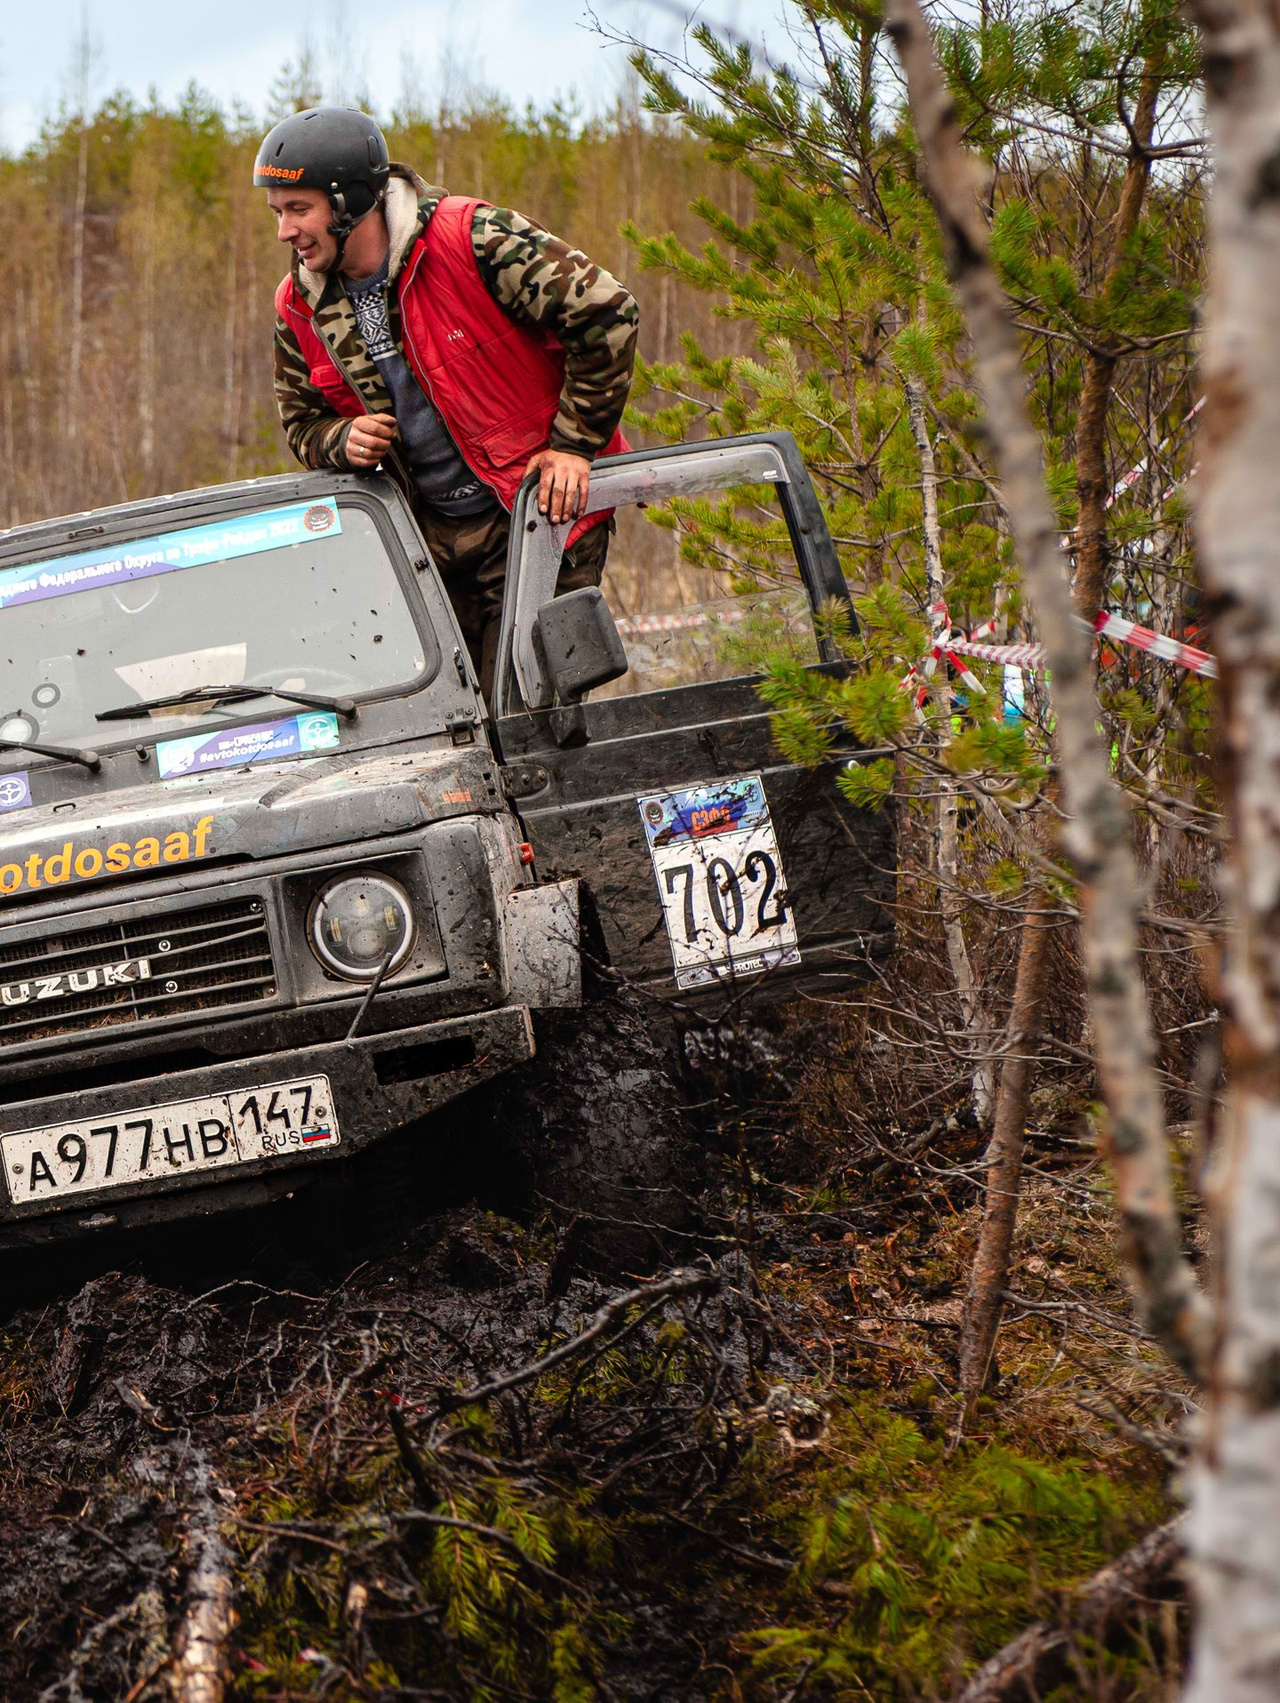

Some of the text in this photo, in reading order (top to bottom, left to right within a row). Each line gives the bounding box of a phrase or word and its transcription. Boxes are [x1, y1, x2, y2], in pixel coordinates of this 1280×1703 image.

[663, 850, 787, 943] 702
[238, 1085, 313, 1135] 147
[261, 1131, 300, 1152] RUS
